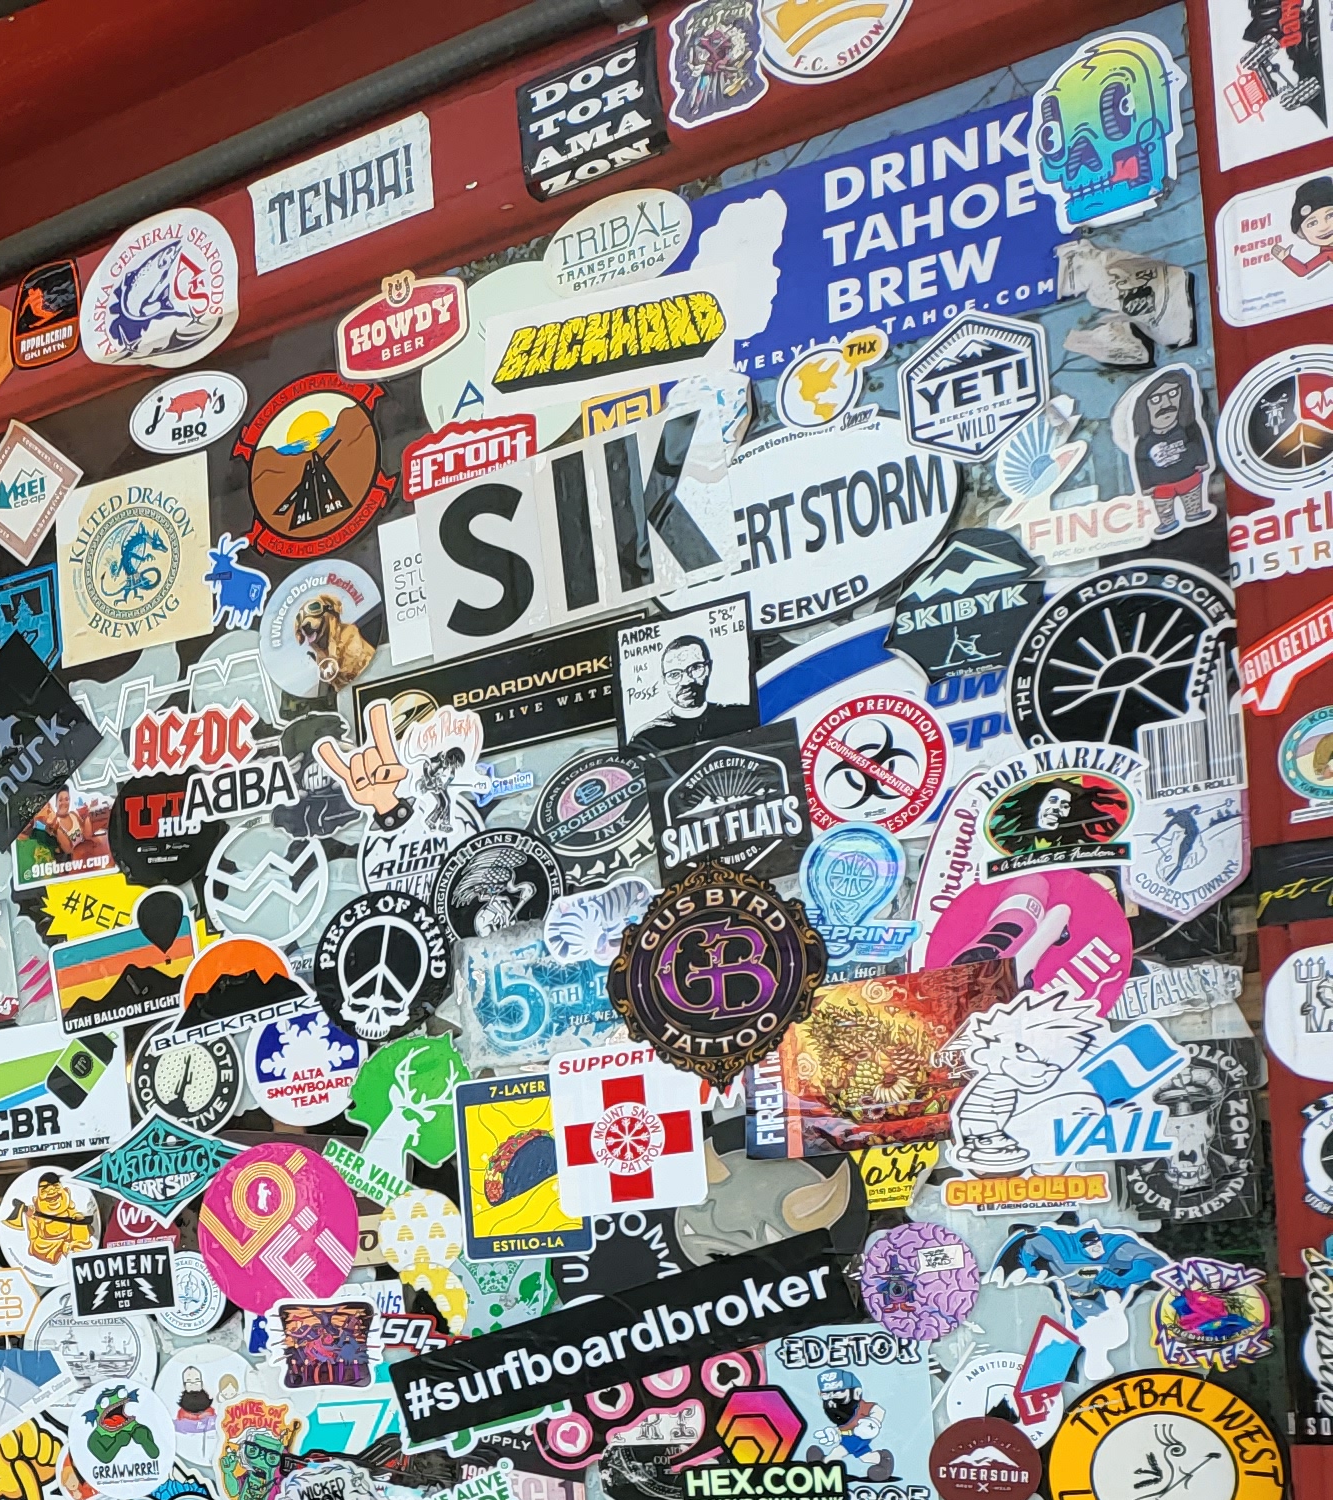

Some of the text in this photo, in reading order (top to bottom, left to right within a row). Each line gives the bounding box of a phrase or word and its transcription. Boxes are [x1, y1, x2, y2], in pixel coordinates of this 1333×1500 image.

[530, 48, 642, 110] DOC
[529, 80, 644, 140] TOR
[530, 109, 652, 175] AMA
[824, 112, 1031, 212] DRINK
[541, 138, 652, 198] ZON
[555, 201, 682, 264] TRIBAL
[822, 178, 1037, 268] TAHOE
[1234, 234, 1282, 256] Pearson
[1241, 213, 1271, 233] Hey!
[572, 252, 665, 292] 817.774.6104
[827, 236, 1002, 322] BREW
[350, 292, 455, 349] HOWDY
[381, 336, 424, 362] BEER
[845, 338, 879, 358] THX
[915, 359, 1030, 411] YETI
[171, 421, 207, 441] BBQ
[957, 414, 997, 439] WILD
[801, 454, 949, 552] STORM
[760, 575, 868, 624] SERVED
[895, 584, 1029, 635] SKIBYK
[621, 625, 661, 647] ANDRE
[978, 744, 1144, 799] BOB MARLEY
[661, 796, 803, 870] SALT FLATS
[153, 999, 321, 1051] BLACKROCK
[558, 1049, 657, 1075] SUPPORT
[488, 1080, 545, 1098] 7-LAYER
[13, 1141, 72, 1154] REDEMPTION
[89, 1136, 111, 1146] WNY
[1053, 1106, 1180, 1156] VAIL
[945, 1178, 1107, 1206] GRINGOLADA
[75, 1253, 169, 1282] MOMENT
[492, 1234, 564, 1253] ESTILO-LA
[405, 1262, 831, 1420] #surfboardbroker
[1071, 1381, 1283, 1486] TRIBAL WEST
[686, 1466, 842, 1497] HEX.COM
[938, 1464, 1030, 1484] CYDERSOUR
